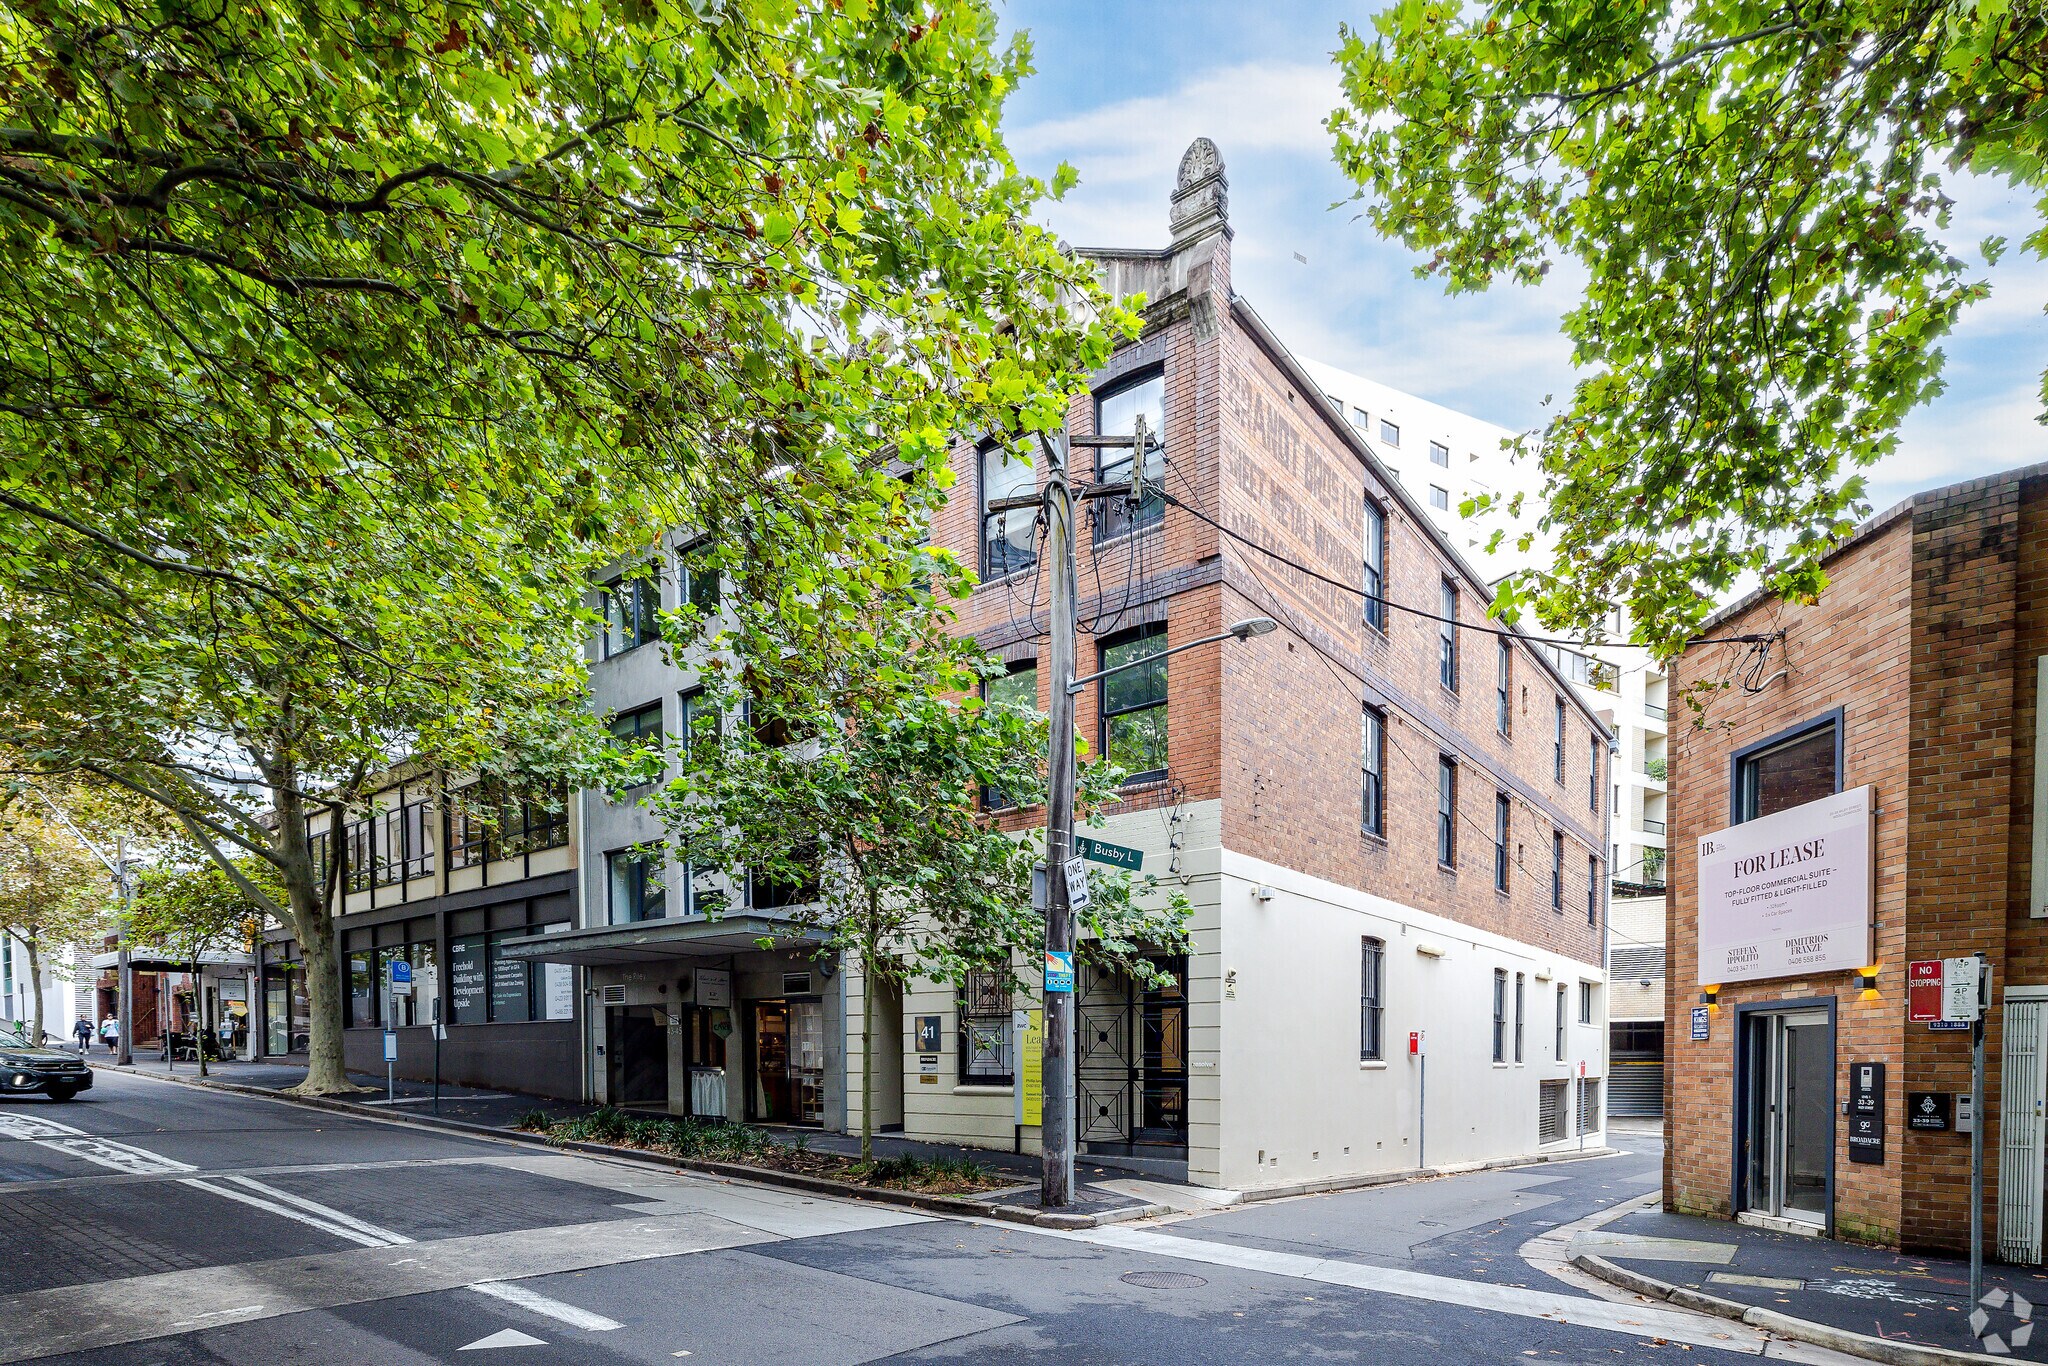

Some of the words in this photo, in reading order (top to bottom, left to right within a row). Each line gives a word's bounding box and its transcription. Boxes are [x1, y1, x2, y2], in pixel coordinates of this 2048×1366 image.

[1313, 516, 1361, 594] WORKERS
[1094, 843, 1125, 862] Busby
[1128, 851, 1134, 862] L
[1734, 855, 1766, 878] FOR
[1770, 838, 1825, 870] LEASE
[1067, 862, 1082, 877] ONE
[1069, 876, 1085, 893] WAY
[1724, 884, 1760, 899] TOP-FLOOR
[1761, 874, 1808, 890] COMMERCIAL
[1809, 868, 1831, 880] SUITE
[1732, 896, 1750, 906] FULLY
[1750, 892, 1773, 903] FITTED
[1780, 880, 1828, 896] LIGHT-FILLED
[1785, 933, 1829, 948] DIMITRIOS
[452, 944, 466, 952] CBRE
[1791, 943, 1822, 955] FRANZE
[1727, 953, 1759, 965] IPPOLITO
[453, 960, 474, 972] Freehold
[1919, 966, 1933, 974] NO
[453, 974, 473, 984] Building
[473, 972, 484, 982] with
[1910, 978, 1942, 988] STOPPING
[454, 986, 484, 996] Development
[454, 998, 470, 1010] Upside
[921, 1026, 934, 1039] 41
[1026, 1034, 1041, 1044] Lea
[1860, 1121, 1871, 1130] go
[1850, 1136, 1880, 1145] BROADACRE
